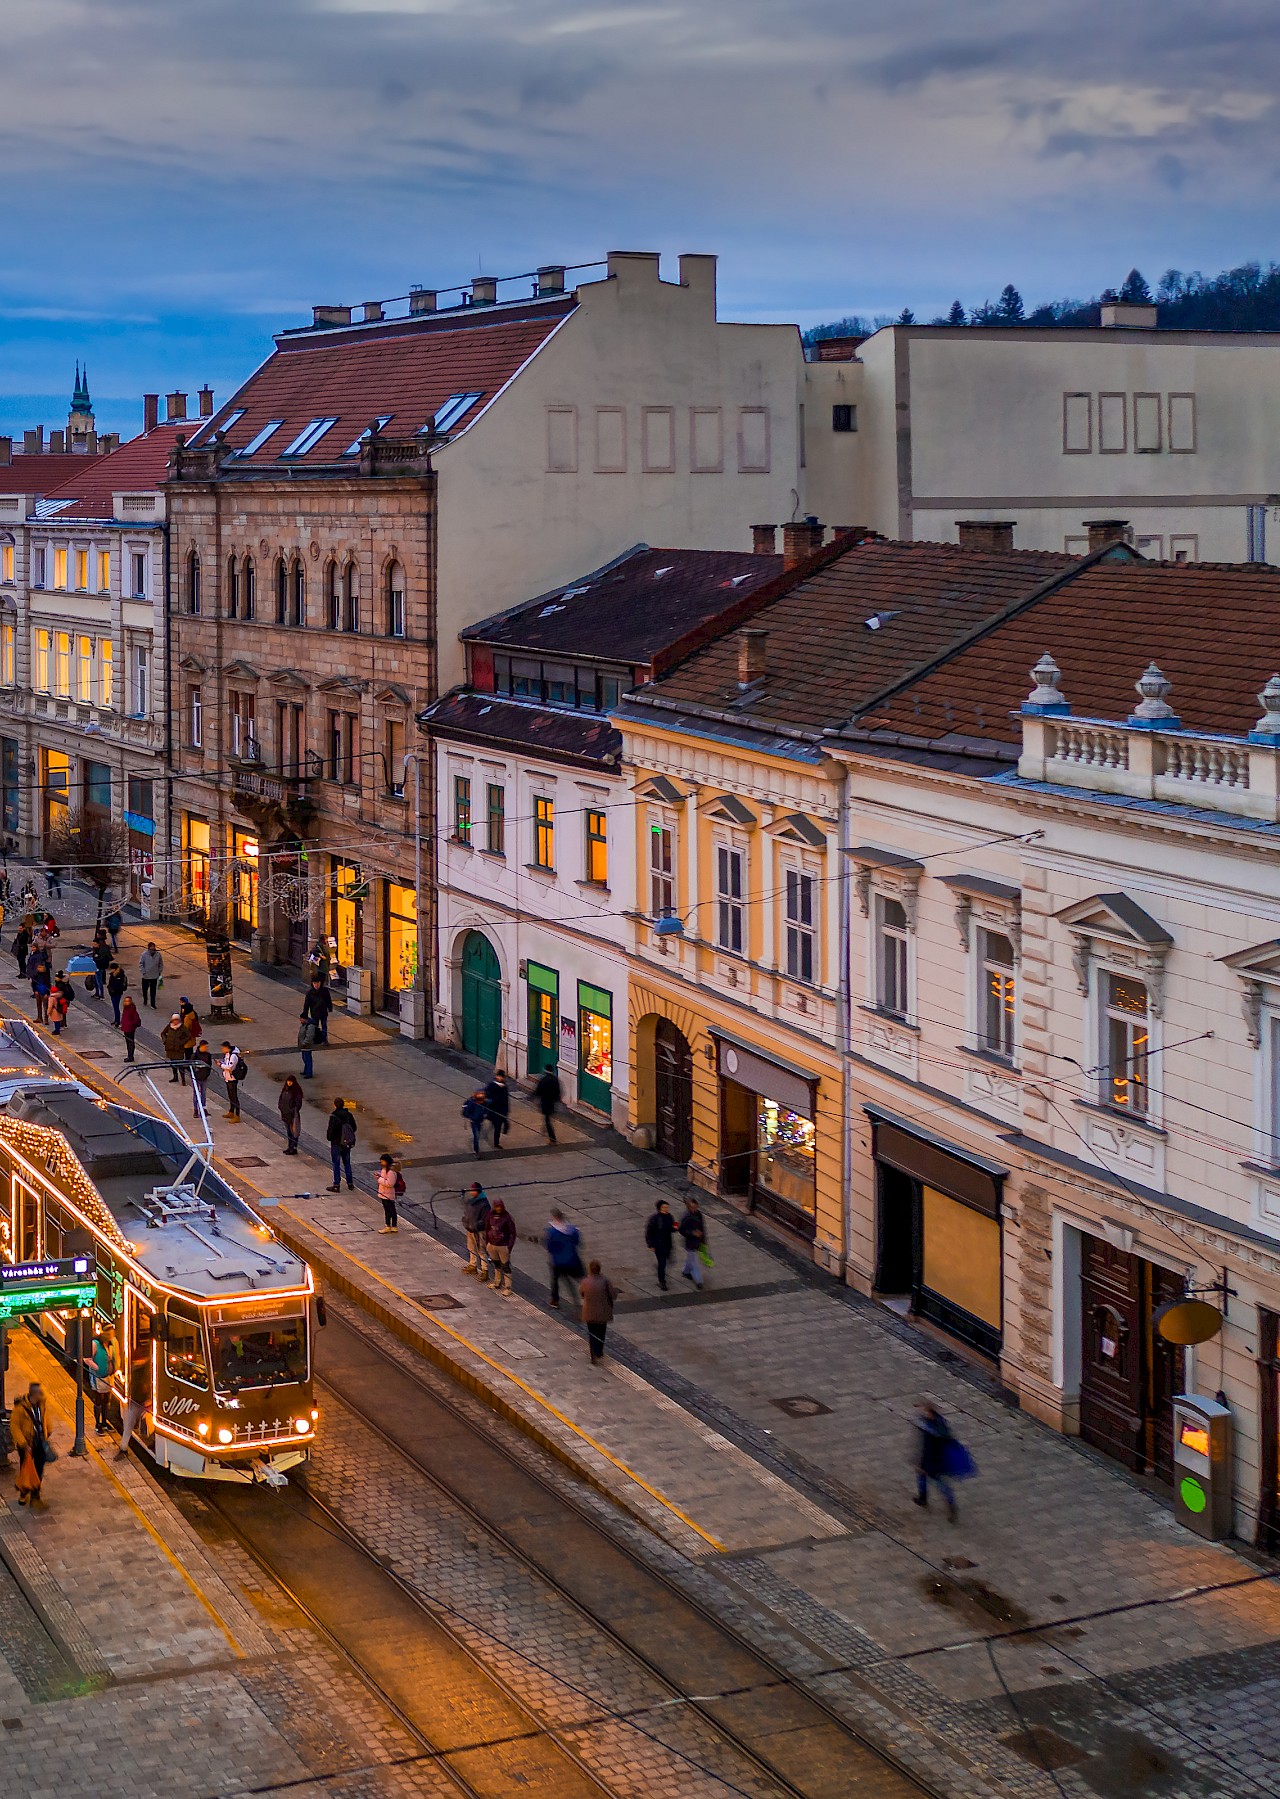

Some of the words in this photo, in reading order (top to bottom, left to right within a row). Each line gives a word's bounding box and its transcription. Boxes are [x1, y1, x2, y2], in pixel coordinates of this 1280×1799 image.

[2, 1266, 44, 1278] Városház
[45, 1265, 59, 1275] tér
[217, 1309, 224, 1322] 1
